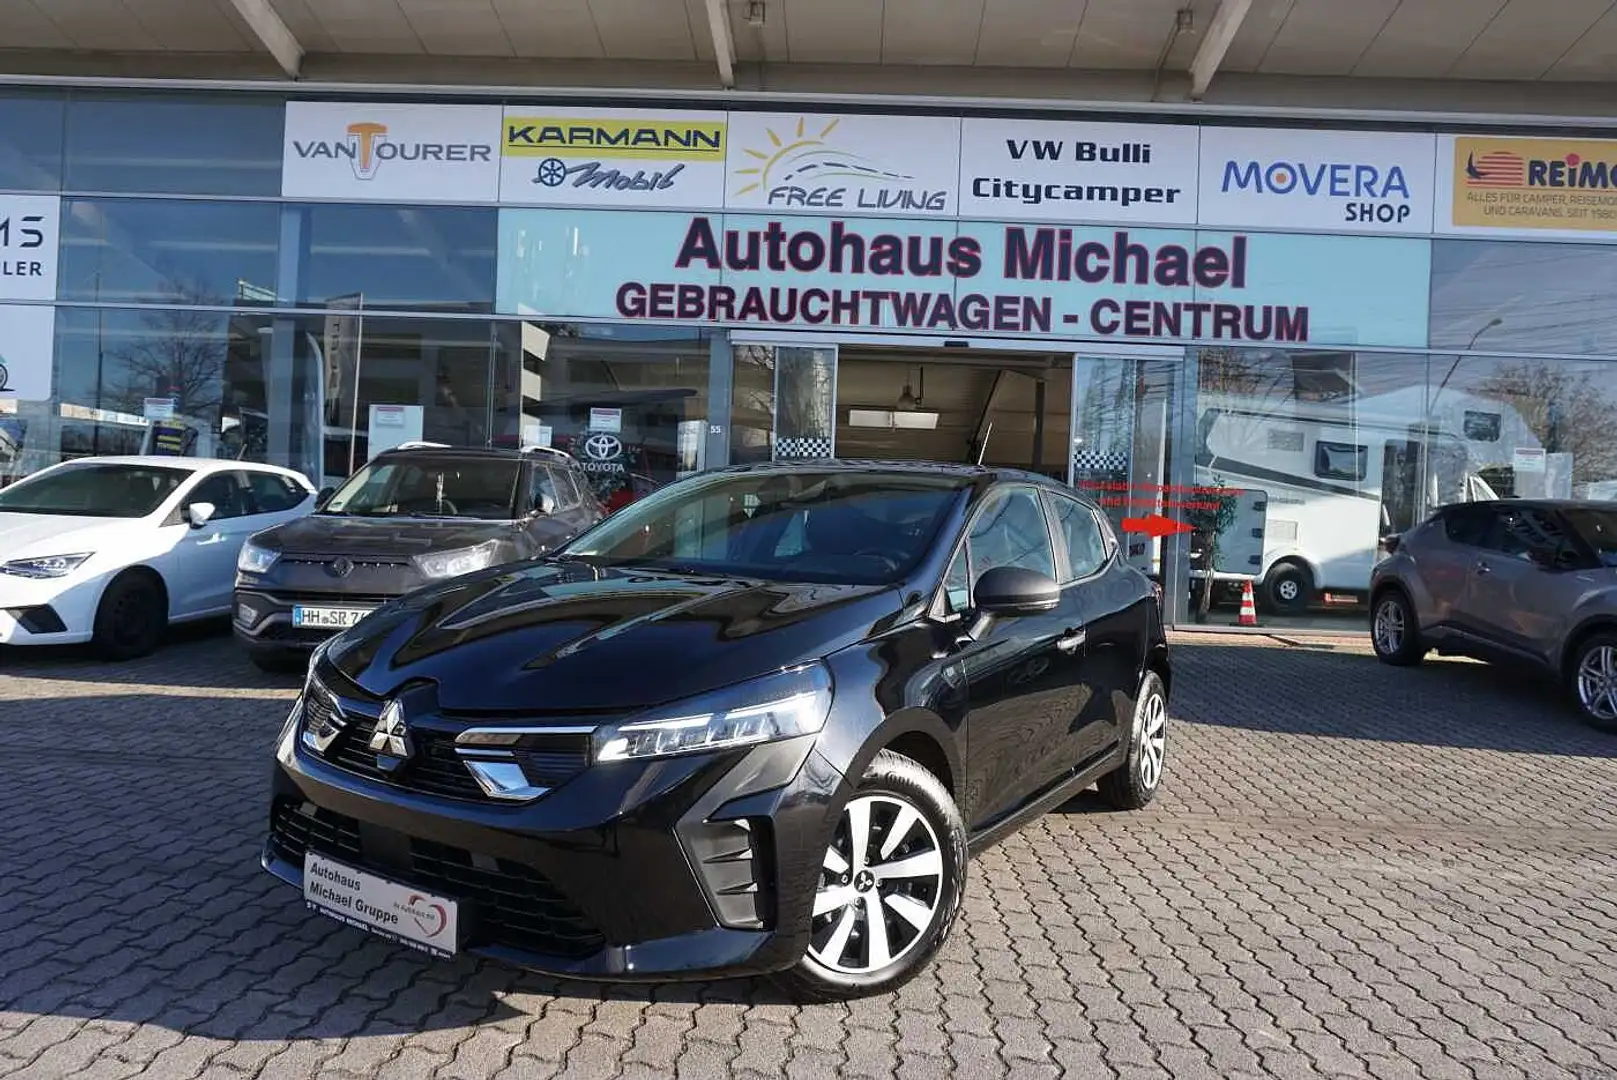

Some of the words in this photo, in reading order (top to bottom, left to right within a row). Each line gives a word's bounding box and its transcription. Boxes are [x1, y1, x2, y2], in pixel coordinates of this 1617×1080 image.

[293, 122, 491, 170] VANTOURER
[509, 125, 721, 149] KARMANN
[1006, 138, 1063, 162] VW
[1075, 140, 1151, 164] Bulli
[972, 176, 1181, 205] Citycamper
[1221, 159, 1410, 199] MOVERA
[768, 185, 845, 208] FREE
[857, 187, 947, 211] LIVING
[1467, 191, 1498, 203] ALLES
[1345, 202, 1411, 223] SHOP
[1484, 205, 1507, 217] UND
[1567, 208, 1588, 219] SEIT
[675, 217, 982, 278] Autohaus
[1003, 227, 1248, 288] Michael
[616, 281, 1052, 332] GEBRAUCHTWAGEN
[1090, 298, 1309, 342] CENTRUM
[710, 425, 722, 434] 55
[581, 462, 625, 473] TOYOTA
[310, 862, 361, 891] Autohaus
[310, 881, 353, 908] Michael
[355, 898, 399, 925] Gruppe
